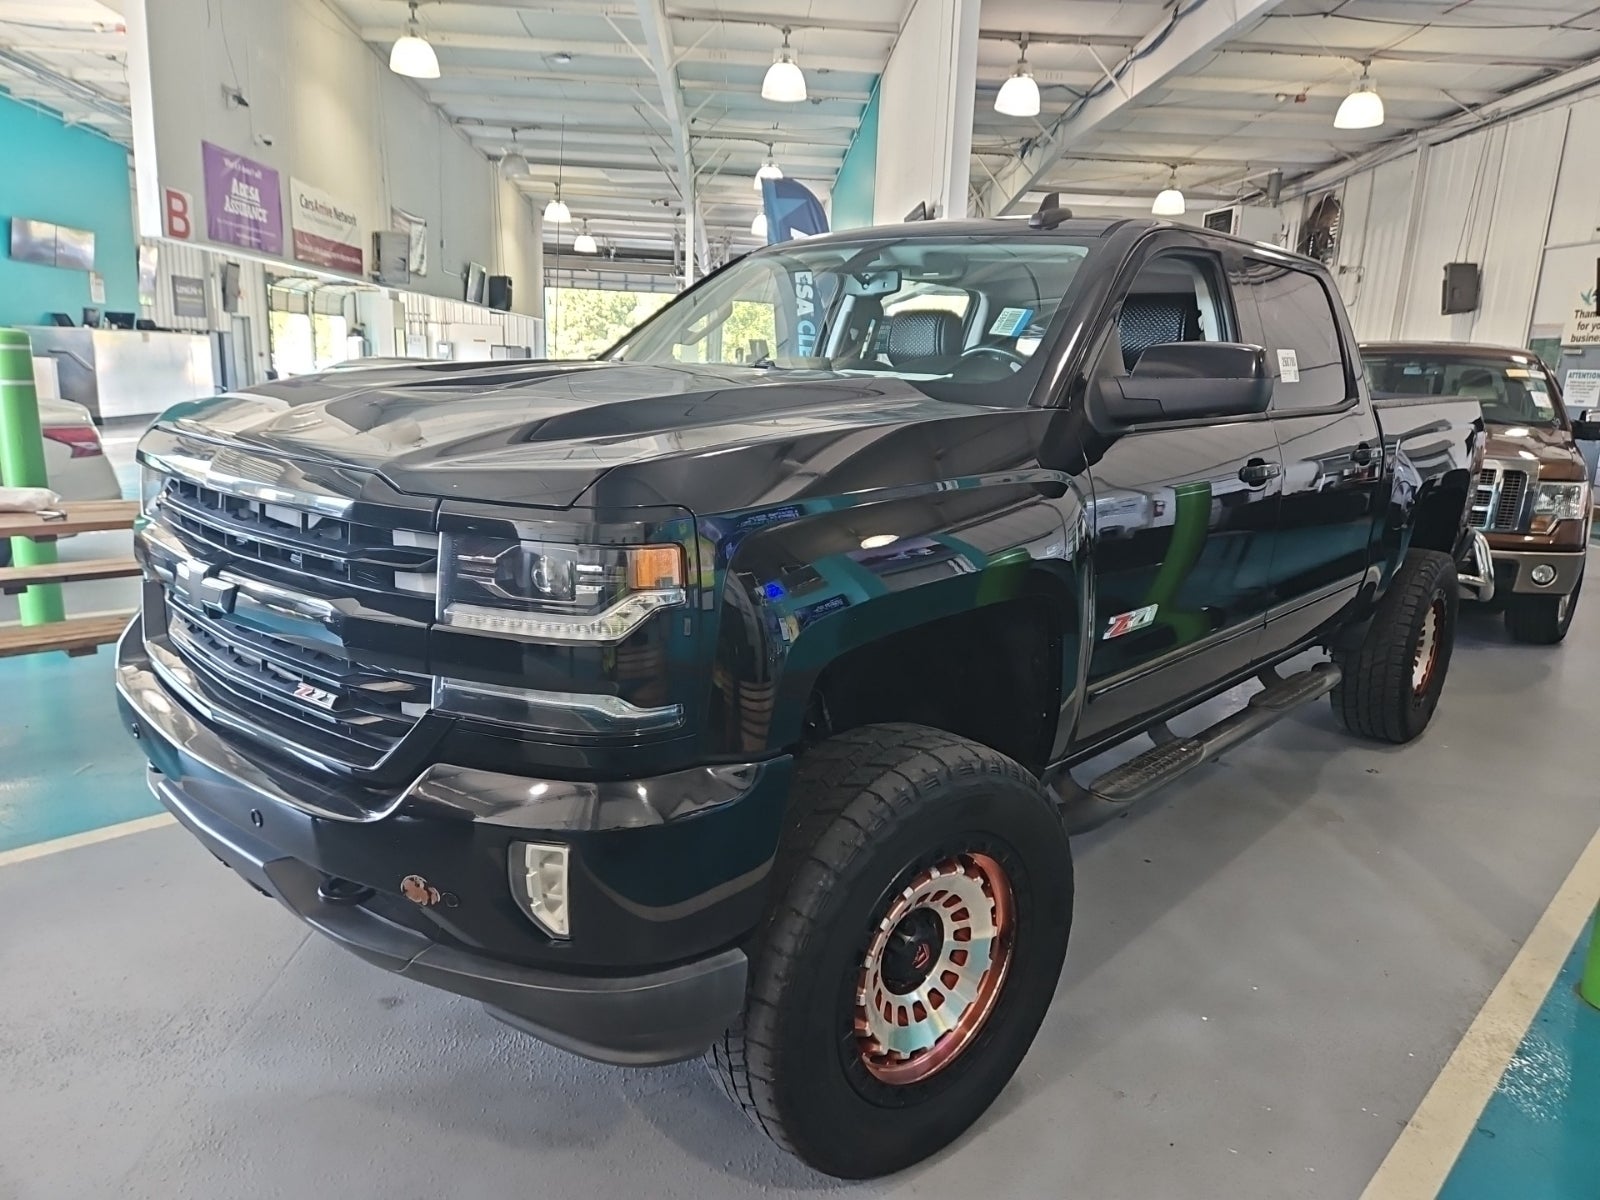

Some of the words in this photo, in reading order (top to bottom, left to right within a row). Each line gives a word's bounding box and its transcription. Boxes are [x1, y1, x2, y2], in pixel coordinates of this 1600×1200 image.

[165, 189, 191, 239] B
[1576, 321, 1590, 331] for
[1102, 603, 1159, 640] Z71
[293, 682, 339, 710] Z71
